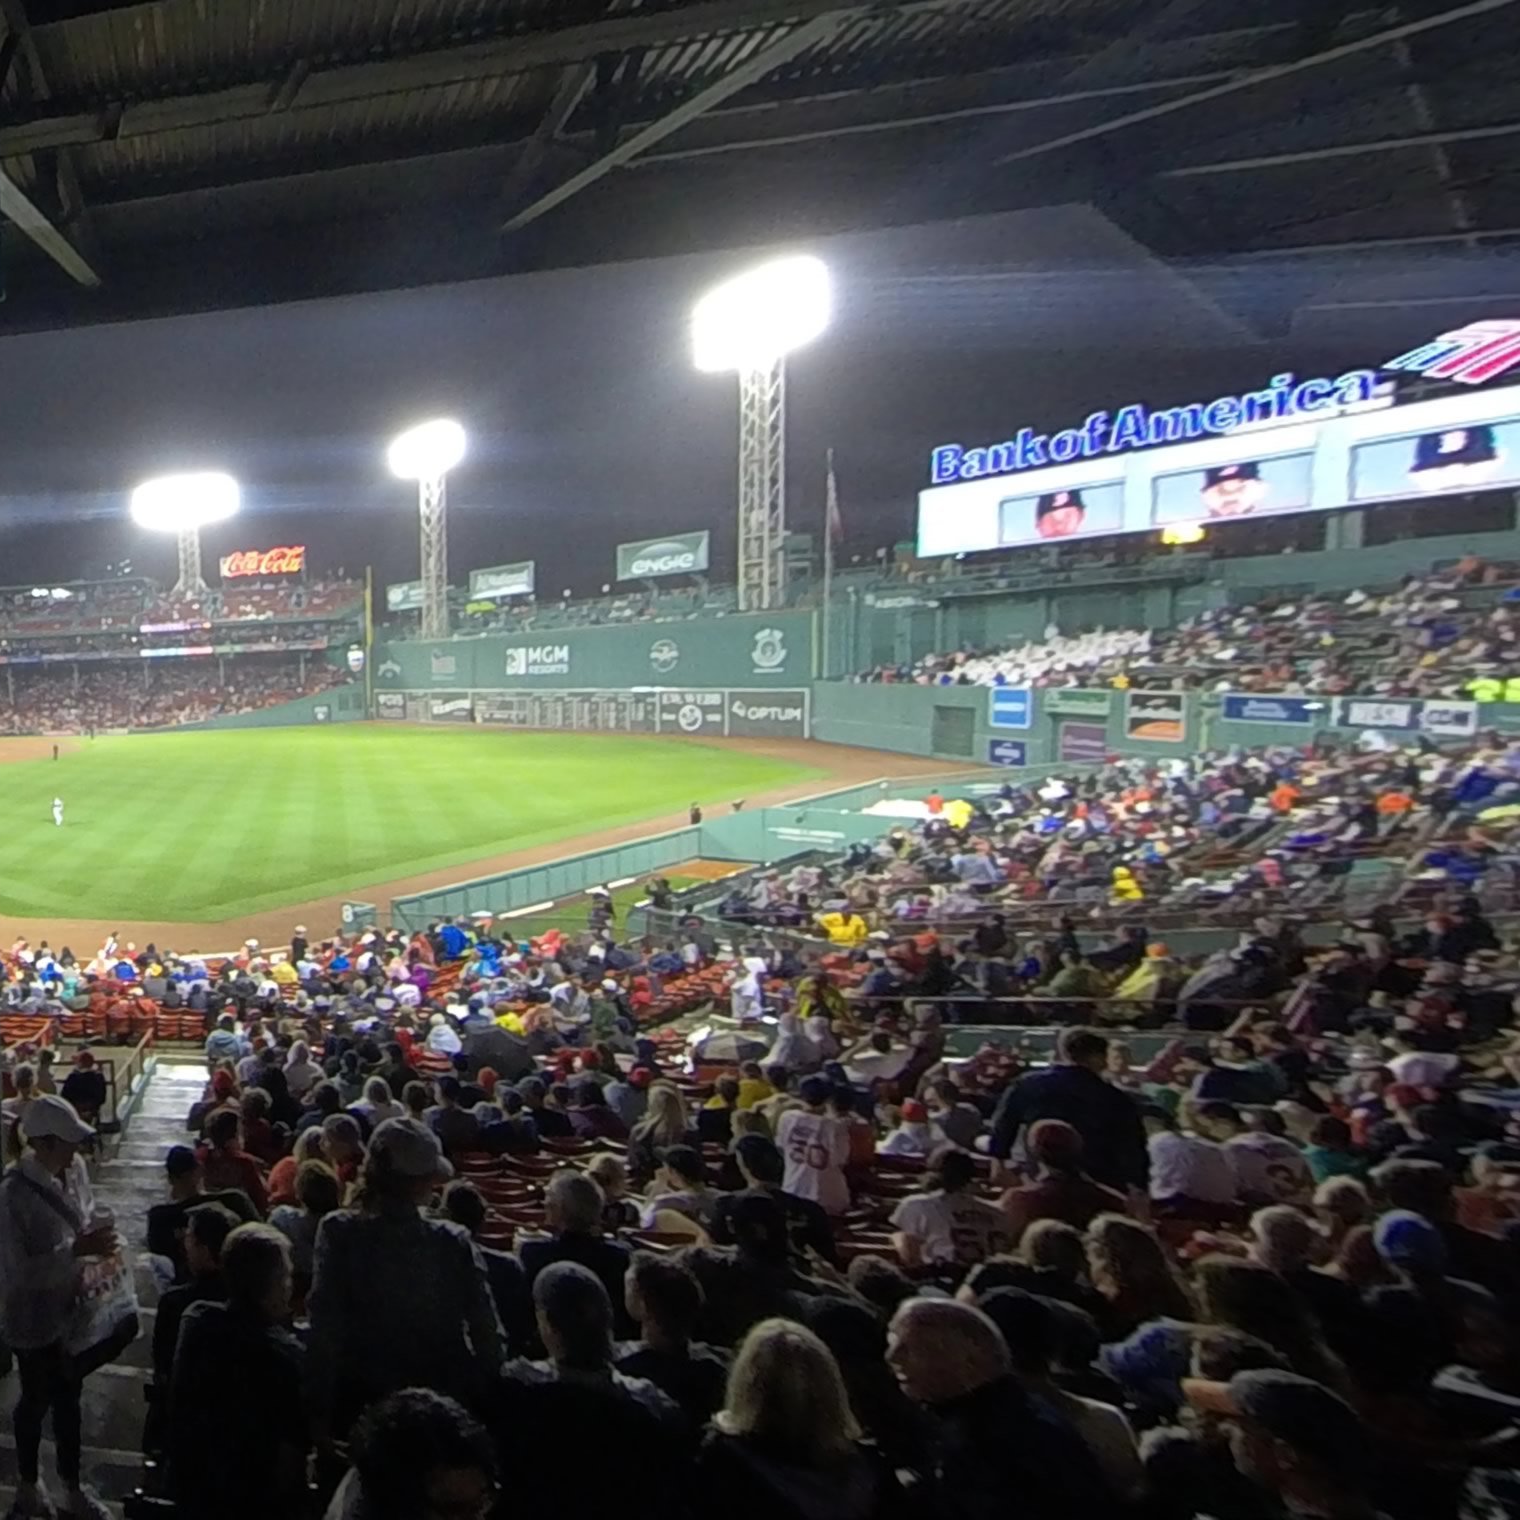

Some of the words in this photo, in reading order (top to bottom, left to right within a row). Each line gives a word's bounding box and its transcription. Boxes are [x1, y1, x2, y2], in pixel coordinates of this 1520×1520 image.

[931, 427, 1048, 483] Bank
[1049, 411, 1110, 461] of
[1111, 369, 1380, 449] America
[528, 644, 569, 663] MGM
[747, 706, 802, 721] OPTUM
